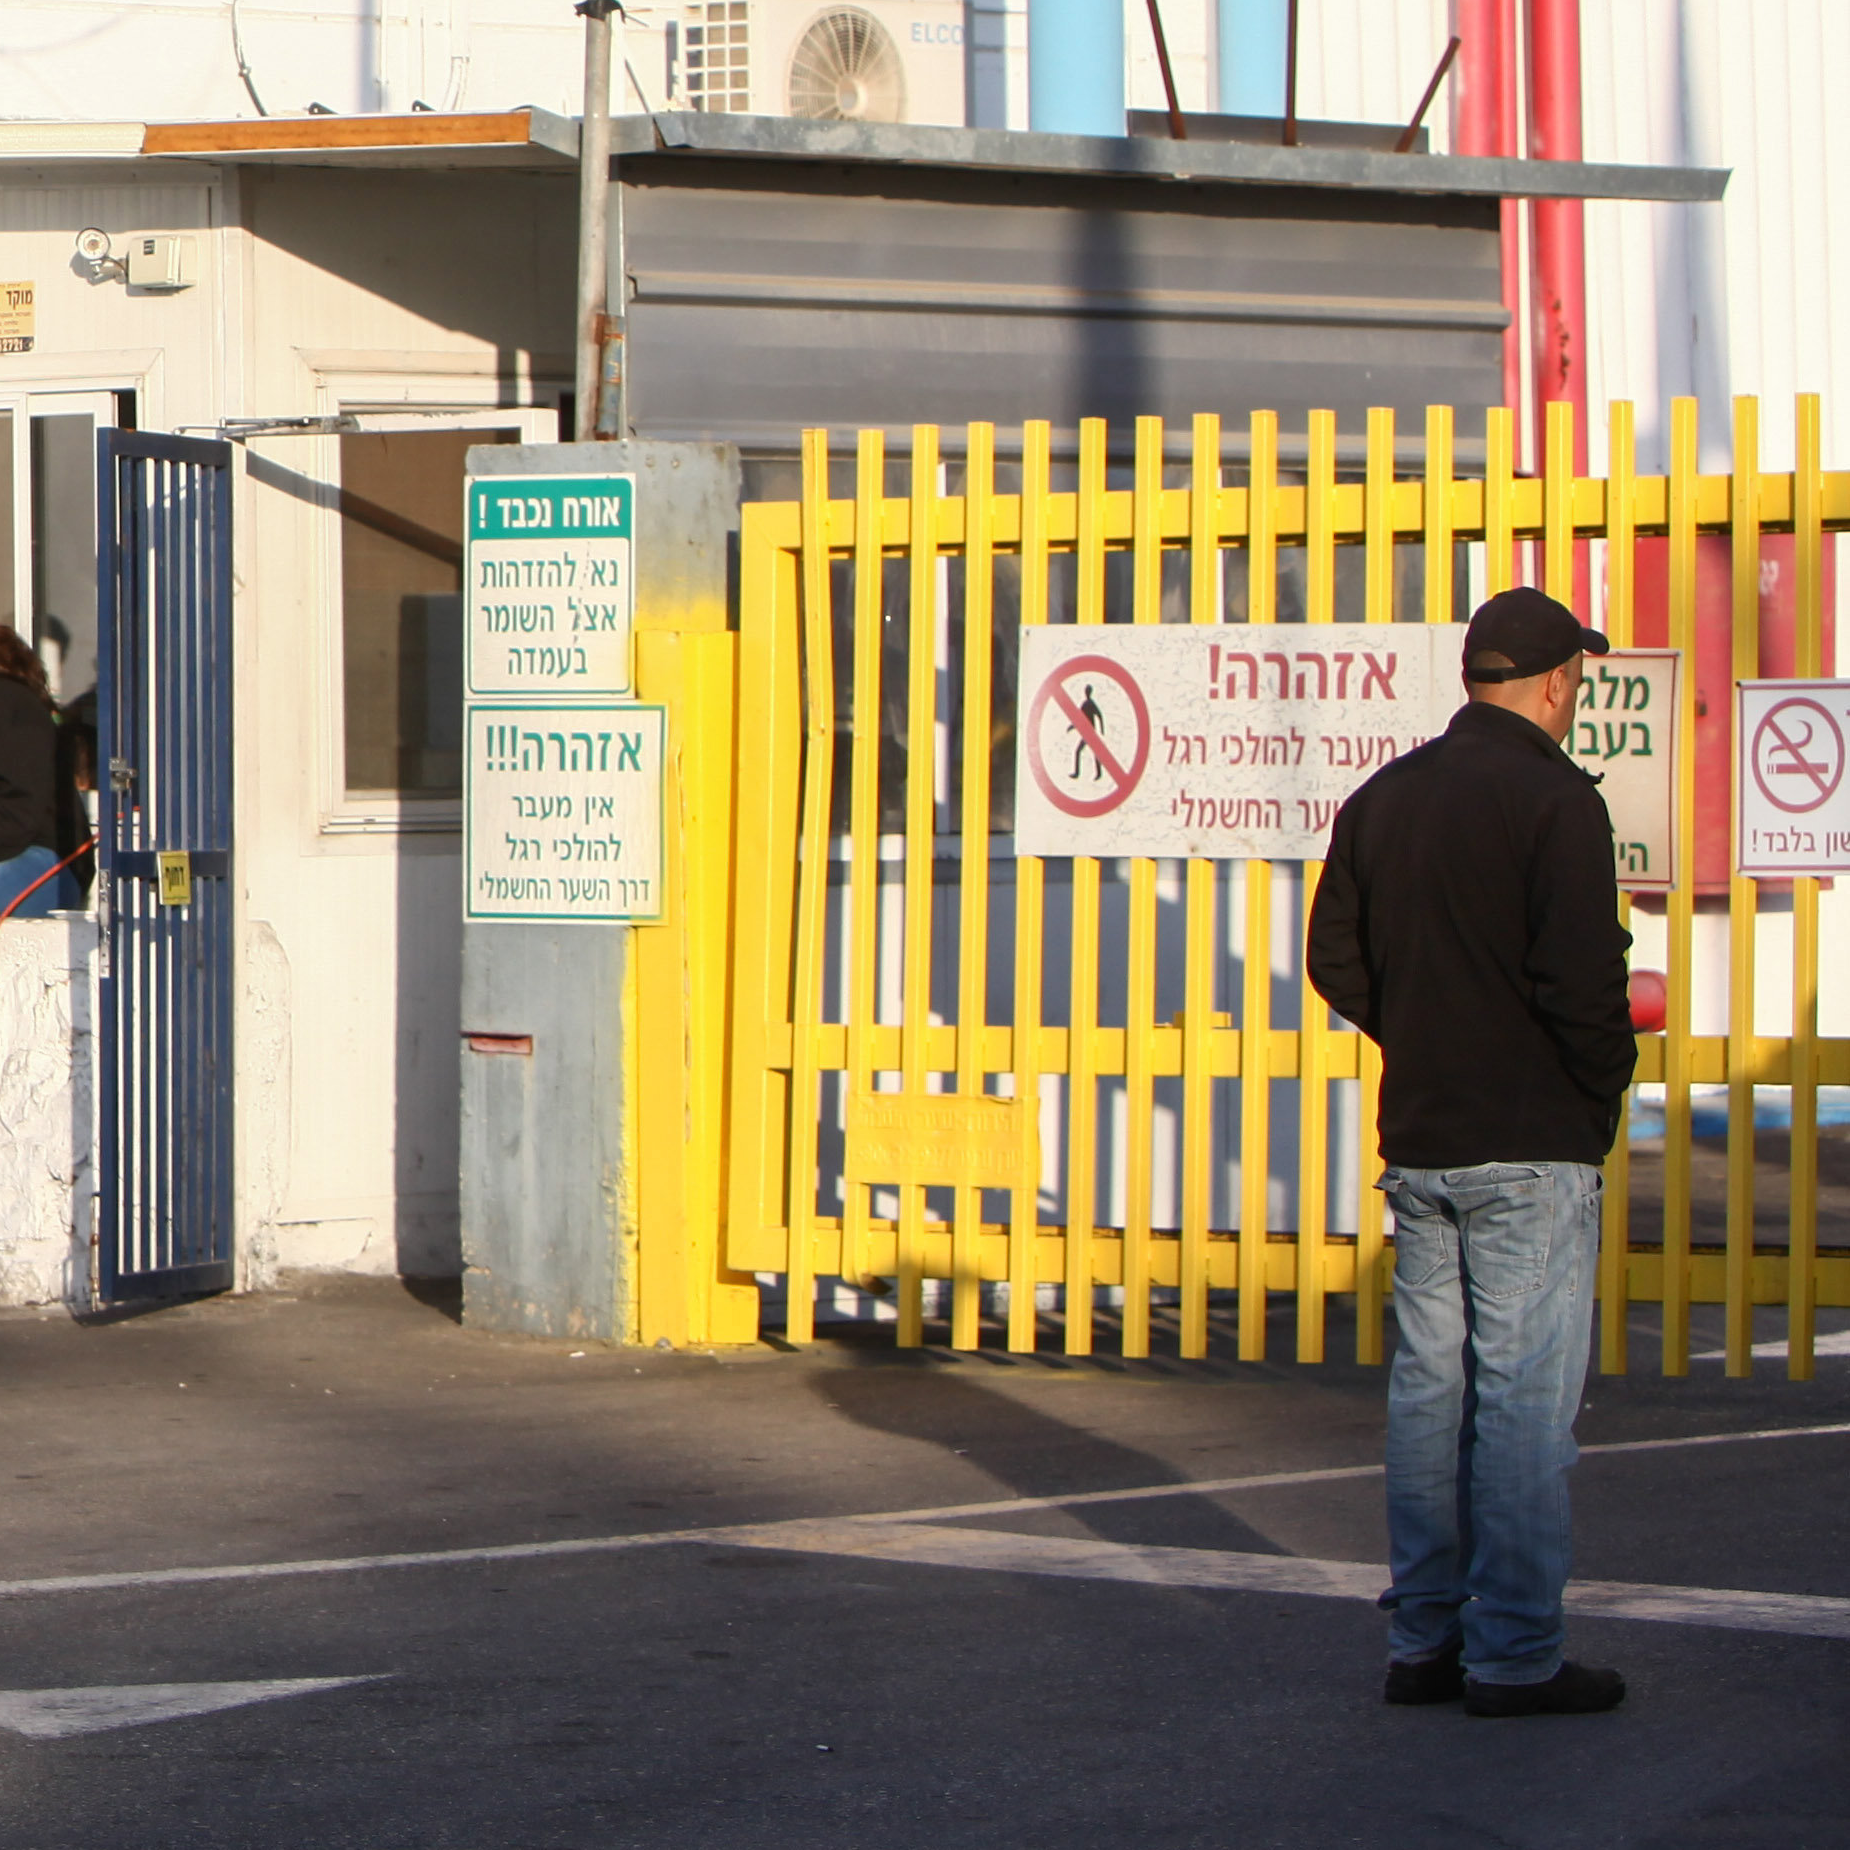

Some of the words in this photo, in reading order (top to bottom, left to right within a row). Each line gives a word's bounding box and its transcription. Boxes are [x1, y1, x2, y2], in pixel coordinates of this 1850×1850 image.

[910, 22, 964, 45] ELCO
[6, 289, 33, 310] מוקד
[497, 496, 553, 529] נכבד
[562, 495, 621, 529] אורח
[480, 552, 577, 589] להזדהות
[590, 560, 618, 587] נא
[480, 605, 554, 633] השומר
[567, 596, 617, 632] אצל
[508, 648, 588, 676] בעמדה
[1209, 644, 1397, 701] אזהרה!
[1580, 666, 1650, 711] מלג
[486, 725, 642, 772] אזהרה!!!
[1162, 726, 1207, 765] רגל
[1221, 726, 1306, 766] להולכי
[1322, 736, 1397, 771] מעבר
[1567, 721, 1653, 761] בעבו
[512, 796, 572, 819] מעבר
[584, 796, 614, 825] אין
[1171, 789, 1283, 830] החשמלי
[505, 832, 541, 861] רגל
[553, 832, 622, 862] להולכי
[1619, 842, 1648, 872] הי
[478, 870, 551, 901] החשמלי
[557, 878, 610, 903] השער
[618, 879, 650, 908] דרך
